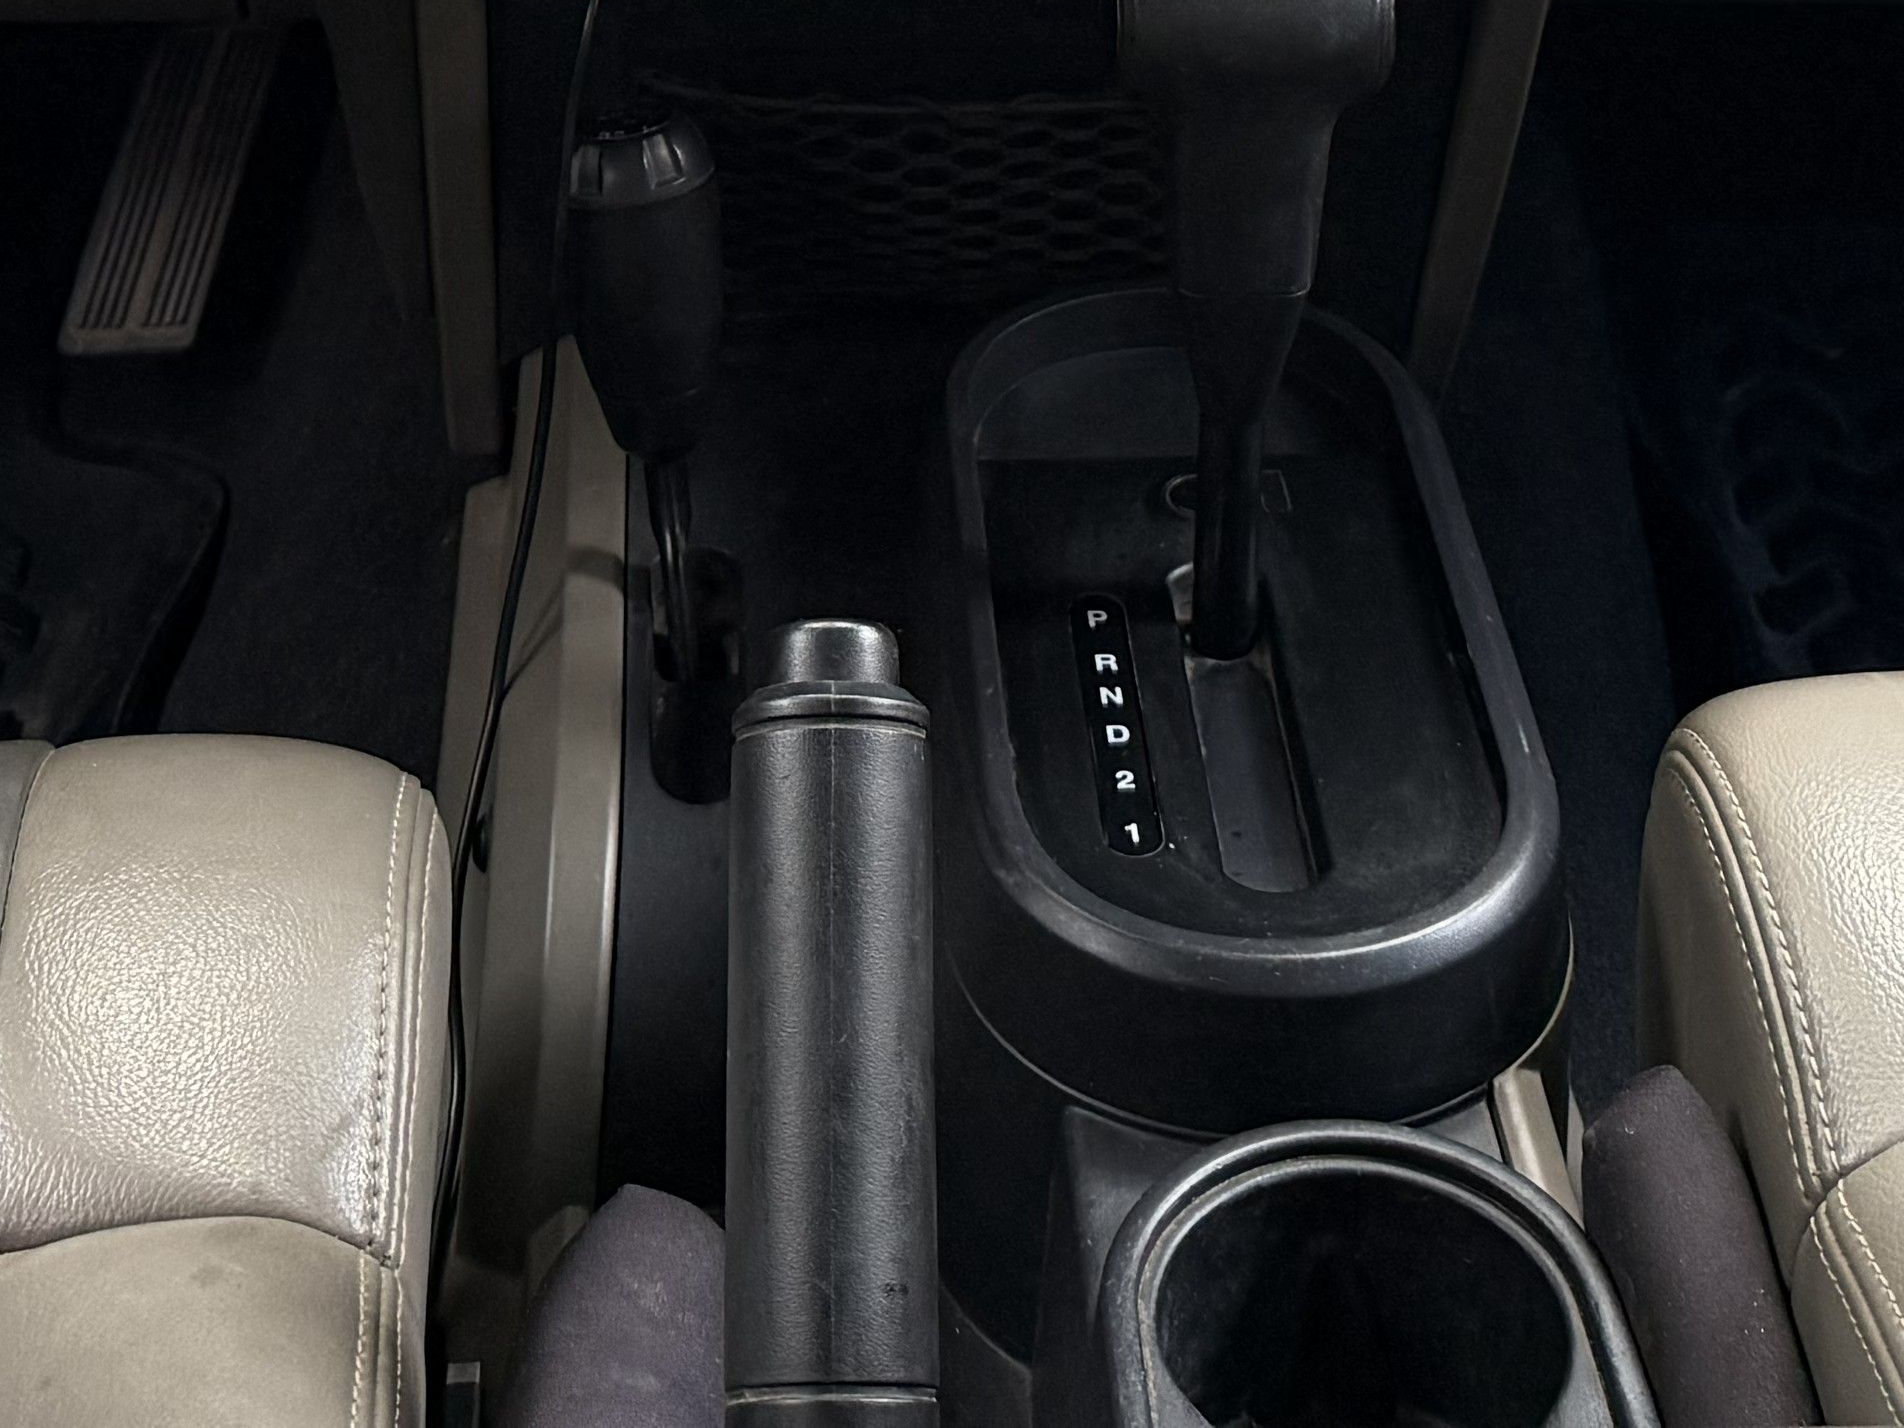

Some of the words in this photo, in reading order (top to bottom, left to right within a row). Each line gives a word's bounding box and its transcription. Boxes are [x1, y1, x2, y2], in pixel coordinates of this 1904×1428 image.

[1087, 610, 1108, 630] P
[1094, 653, 1119, 674] R
[1099, 686, 1124, 708] N
[1105, 723, 1131, 746] D
[1115, 770, 1137, 792] 2
[1124, 822, 1140, 846] 1
